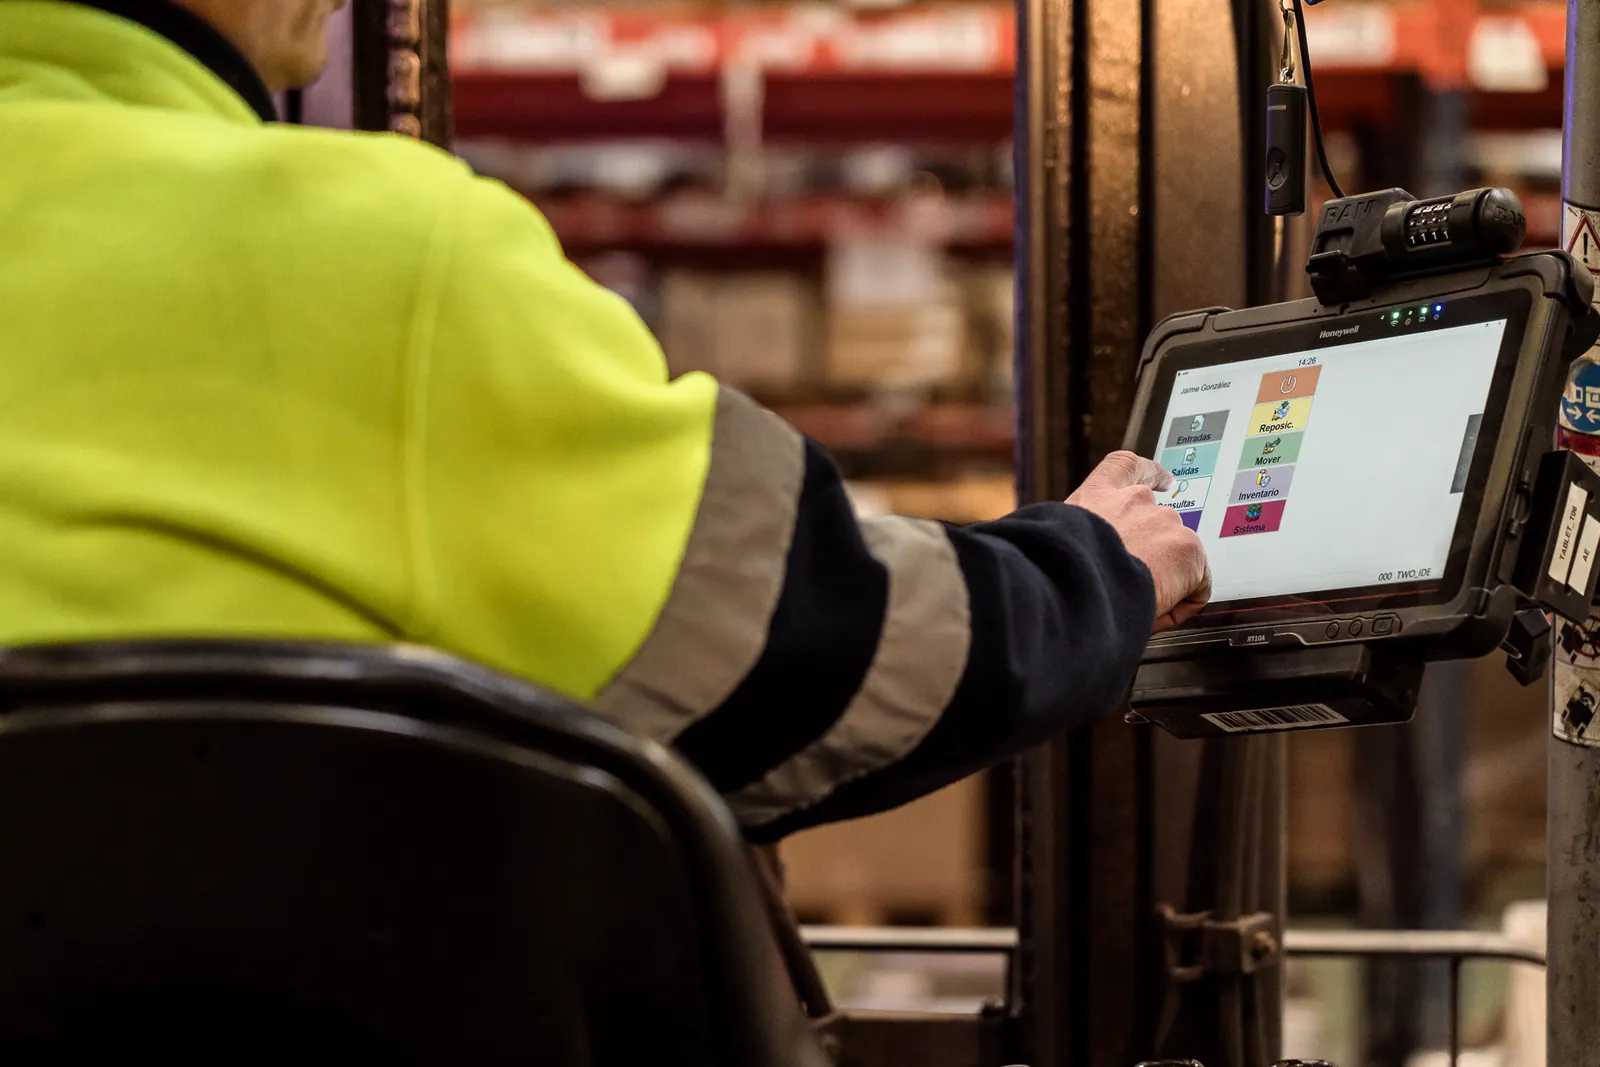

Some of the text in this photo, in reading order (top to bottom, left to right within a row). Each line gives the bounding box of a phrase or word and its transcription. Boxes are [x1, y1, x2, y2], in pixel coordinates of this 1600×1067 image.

[1319, 325, 1360, 339] Honeywell
[1298, 356, 1317, 367] 14:26
[1180, 380, 1232, 395] Jaime González
[1259, 420, 1294, 433] Reposic.
[1176, 432, 1212, 445] Entradas
[1255, 454, 1282, 466] Mover
[1171, 466, 1199, 477] Salidas
[1238, 488, 1280, 501] Inventario
[1233, 522, 1266, 535] Sistema
[1582, 547, 1590, 562] AE
[1397, 567, 1431, 579] TWO_IDE
